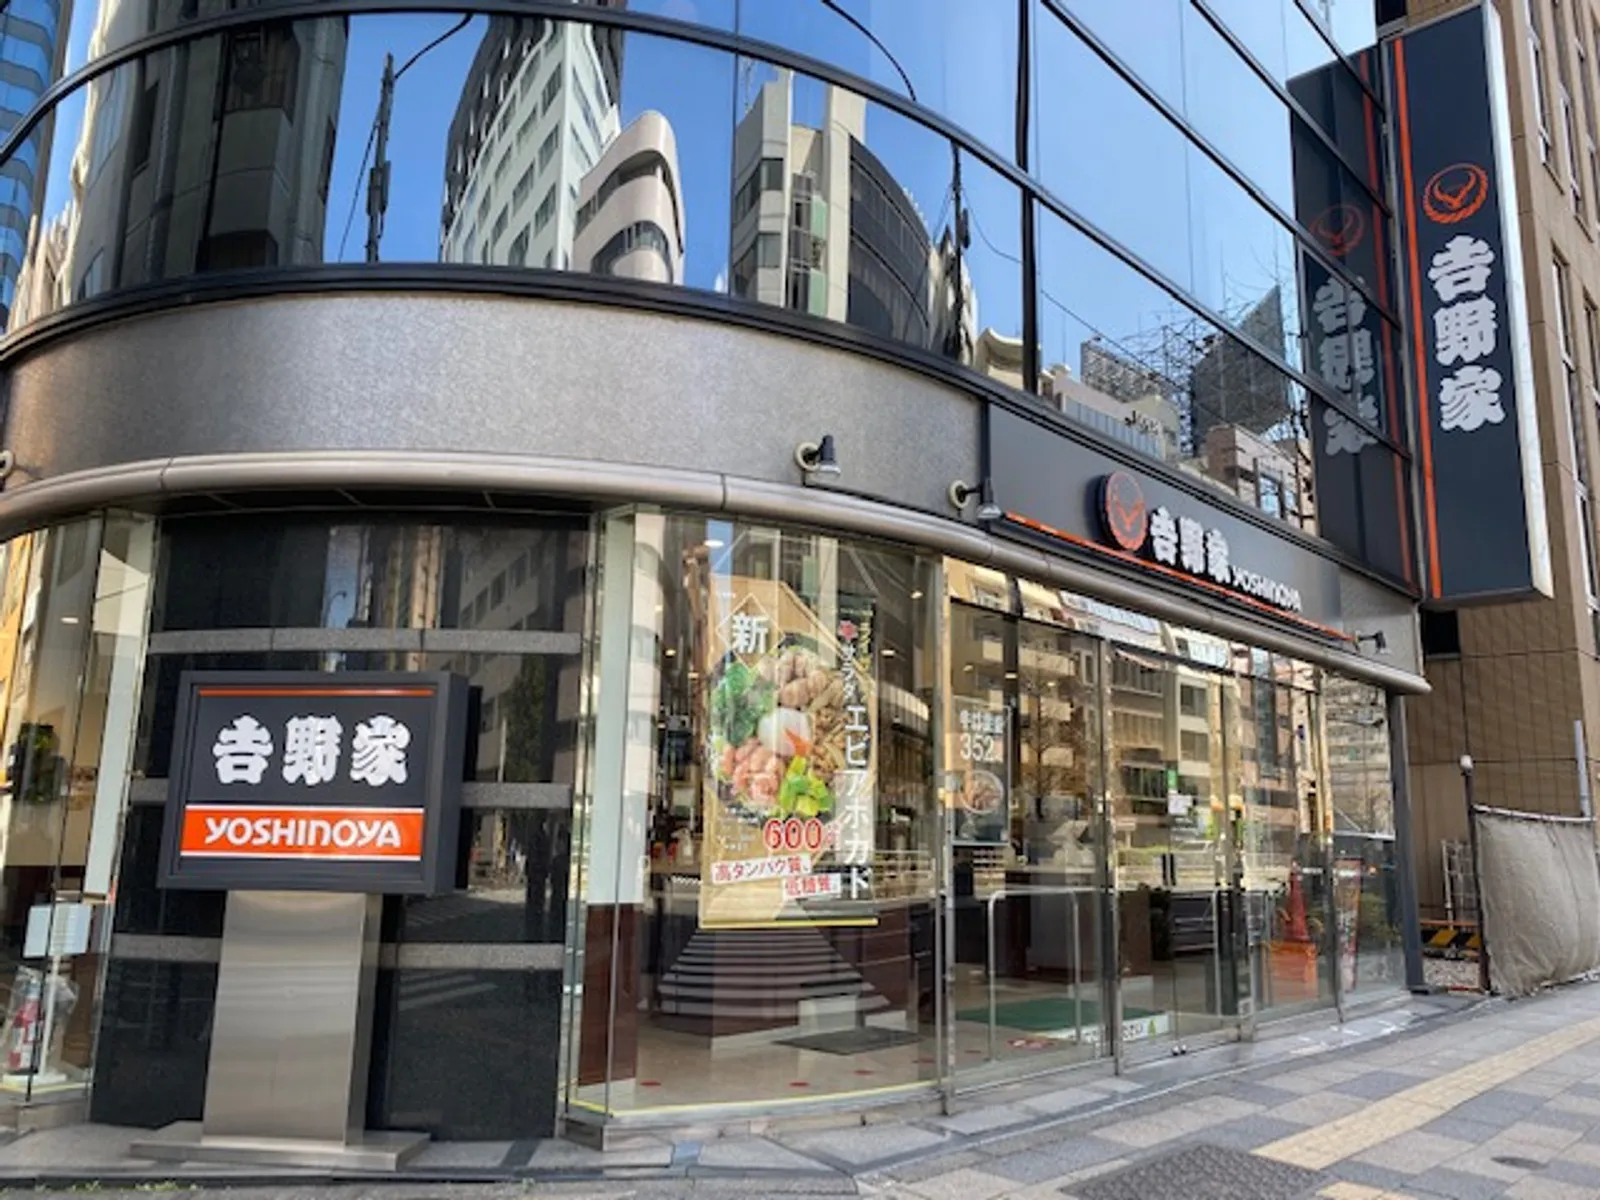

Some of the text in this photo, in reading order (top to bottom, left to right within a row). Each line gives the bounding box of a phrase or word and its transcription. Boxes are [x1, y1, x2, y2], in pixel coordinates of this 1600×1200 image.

[1428, 235, 1506, 431] 吉野家
[1150, 506, 1231, 583] 吉野家
[731, 611, 770, 654] 新
[212, 715, 411, 787] 吉野家
[205, 817, 401, 848] YOSHINOYA
